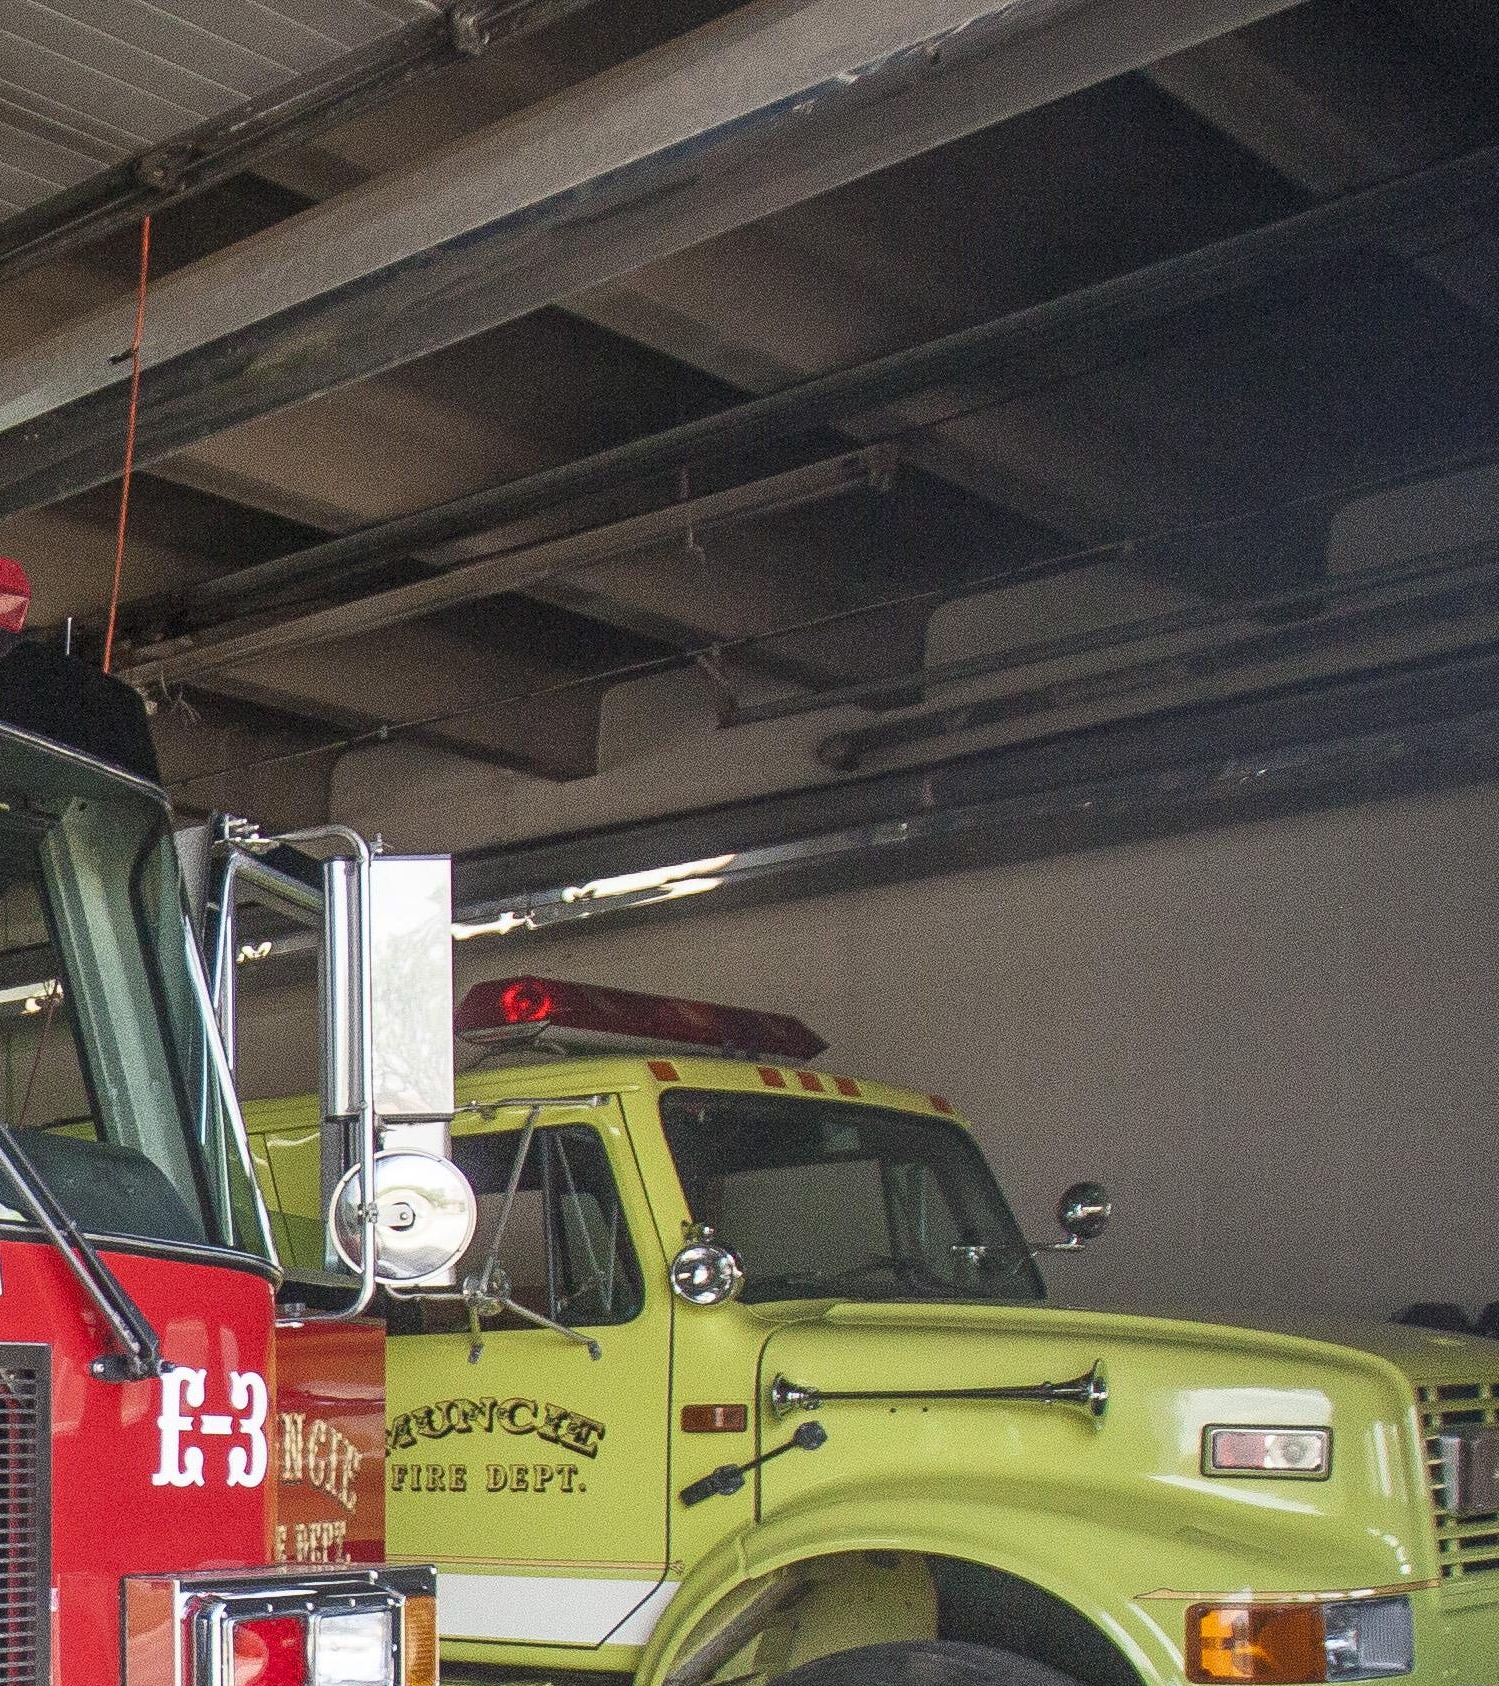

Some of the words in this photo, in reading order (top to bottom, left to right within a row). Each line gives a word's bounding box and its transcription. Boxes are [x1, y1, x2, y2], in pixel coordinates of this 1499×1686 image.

[151, 1366, 268, 1488] E-3
[278, 1412, 363, 1514] NCIE
[390, 1463, 469, 1493] FIRE
[485, 1463, 588, 1493] DEPT.
